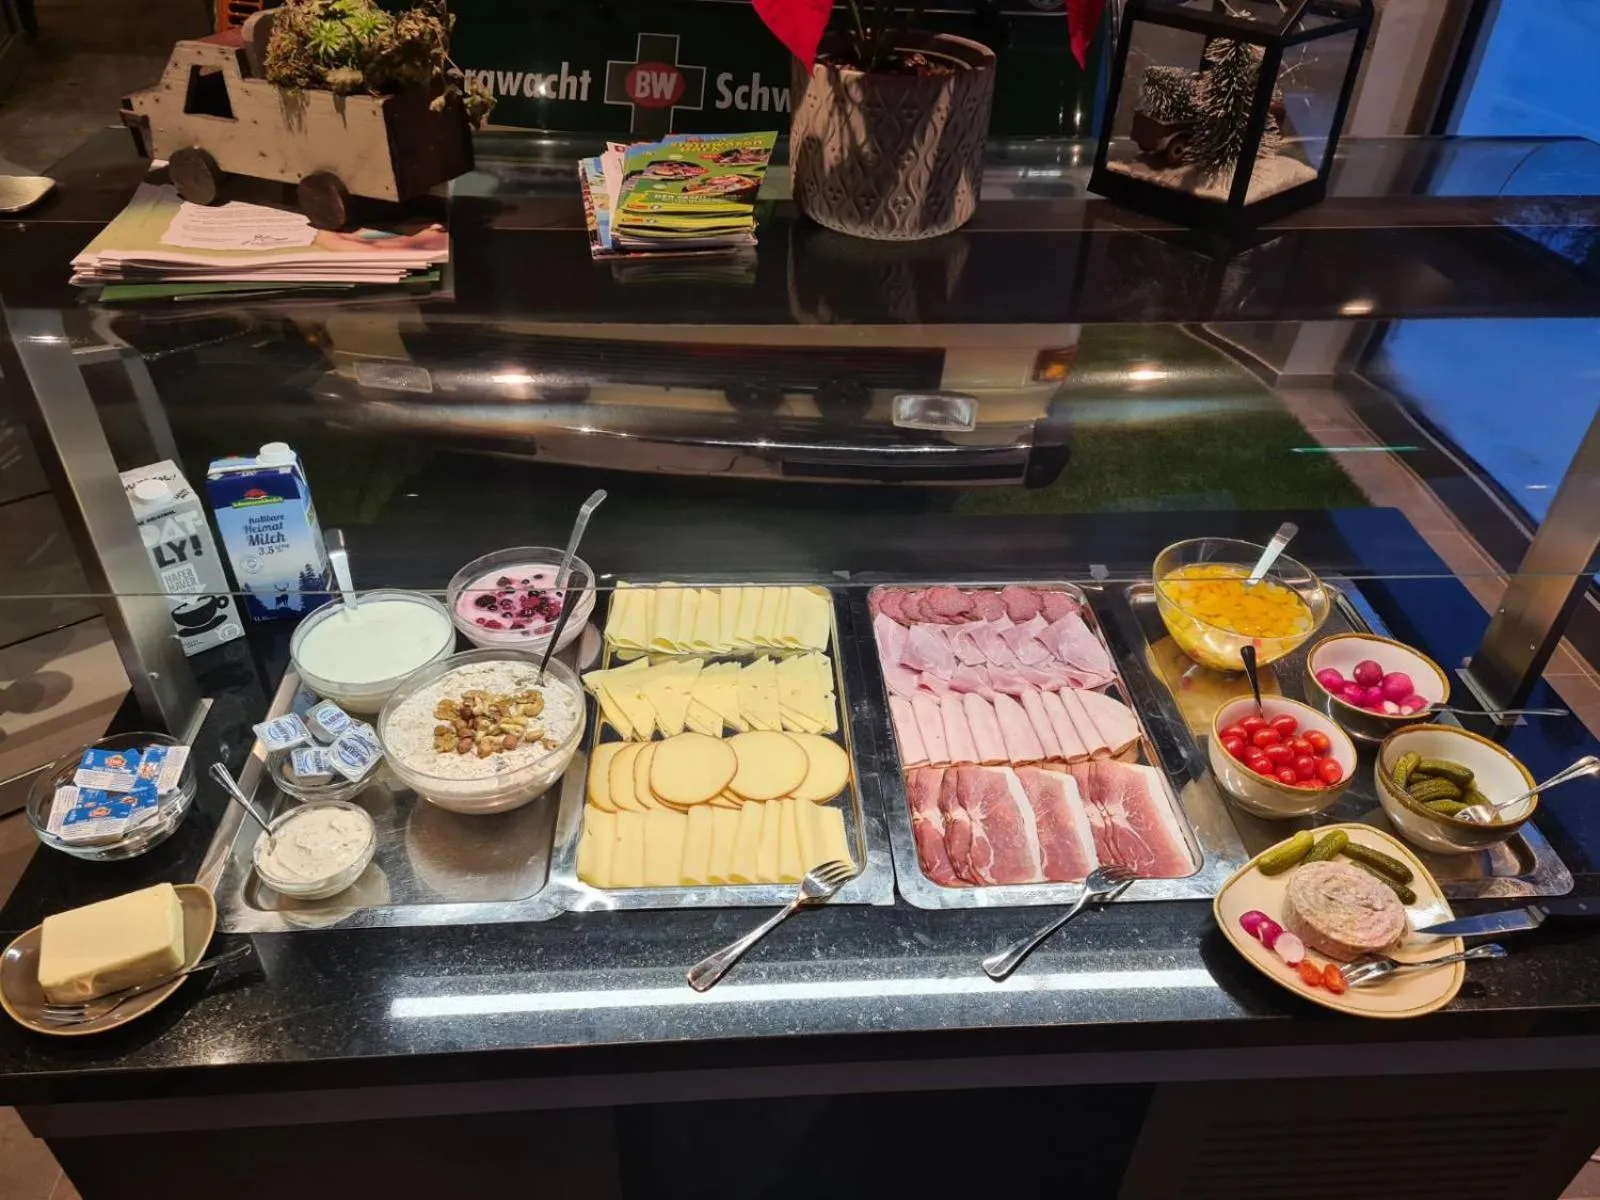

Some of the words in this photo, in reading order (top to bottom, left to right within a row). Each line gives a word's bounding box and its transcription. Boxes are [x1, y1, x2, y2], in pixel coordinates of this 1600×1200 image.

[635, 70, 678, 100] BW
[243, 521, 283, 535] Heimat
[248, 531, 286, 547] Milch
[152, 534, 203, 569] LY!
